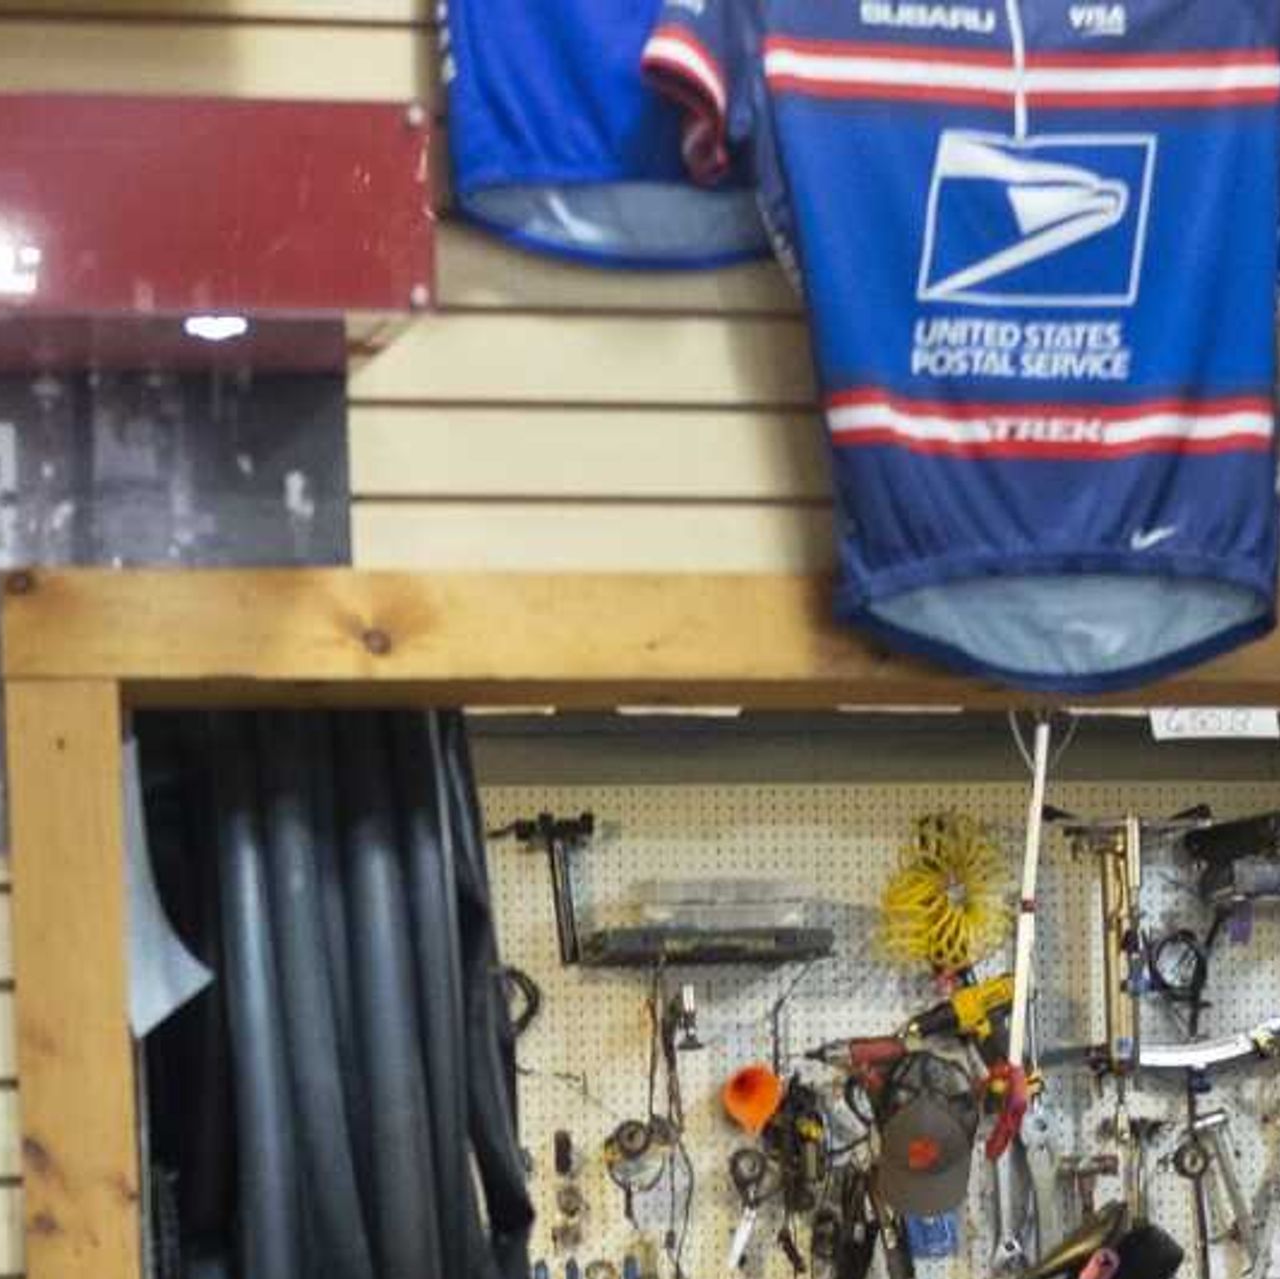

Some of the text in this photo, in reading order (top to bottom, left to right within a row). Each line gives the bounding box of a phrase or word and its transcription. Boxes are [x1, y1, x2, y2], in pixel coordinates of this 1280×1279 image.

[860, 2, 996, 33] SUBARU
[1068, 4, 1126, 32] VISA
[915, 317, 1122, 351] UNITED STATES
[910, 346, 1130, 381] POSTAL SERVICE
